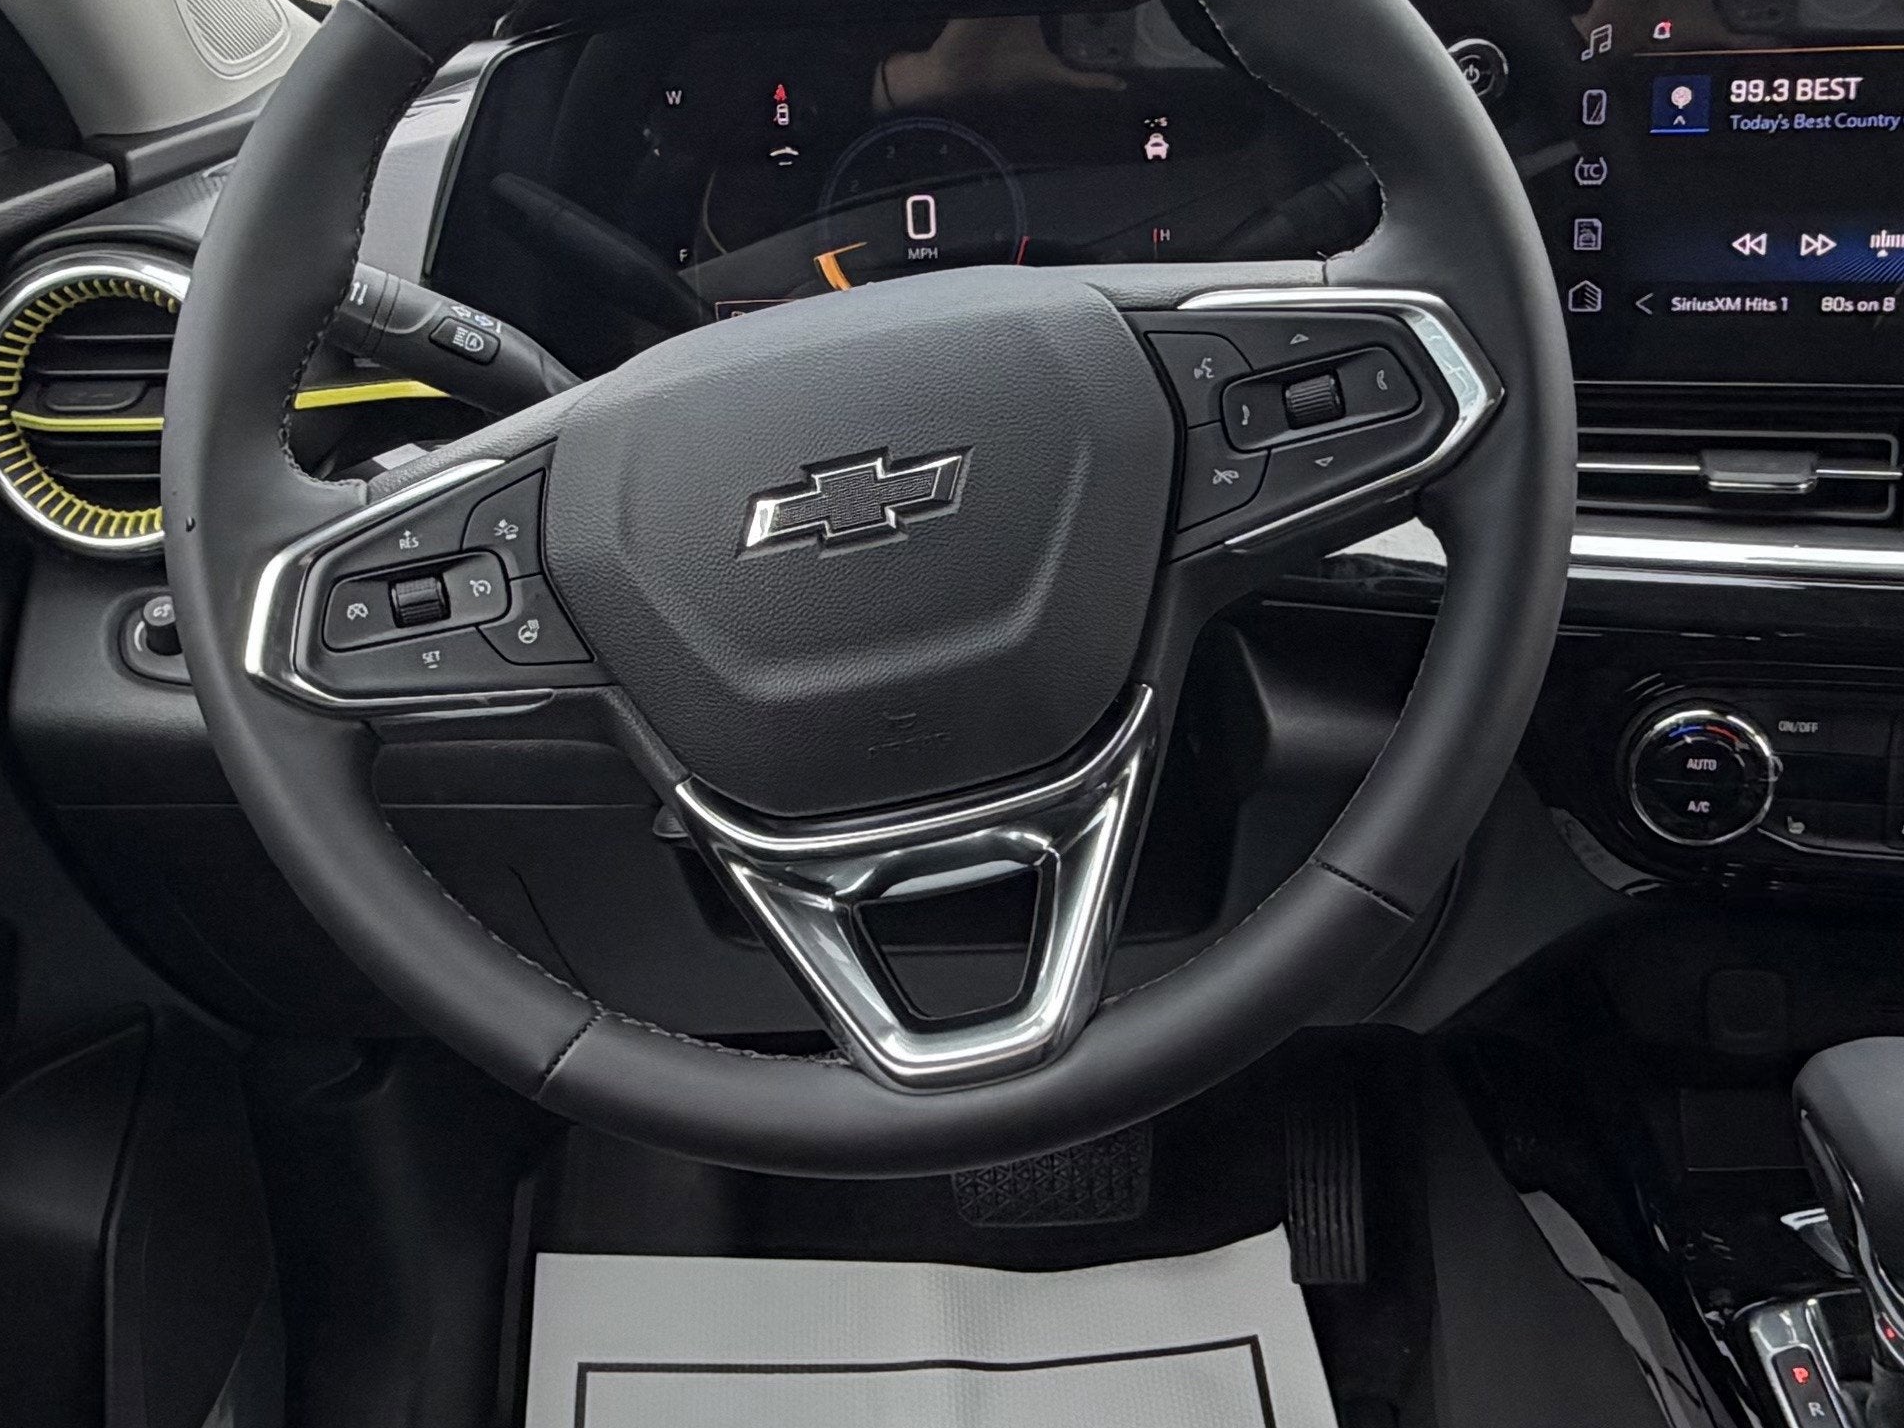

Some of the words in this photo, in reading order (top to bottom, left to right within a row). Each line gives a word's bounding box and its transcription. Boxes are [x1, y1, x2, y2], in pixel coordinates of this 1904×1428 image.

[1730, 79, 1790, 103] 99.3
[1796, 77, 1863, 101] BEST
[665, 90, 684, 106] W
[1730, 113, 1790, 133] Today's
[1794, 113, 1832, 129] Best
[1834, 112, 1900, 131] Country
[906, 194, 937, 240] 0
[1160, 227, 1171, 242] H
[907, 247, 938, 260] MPH
[1671, 296, 1741, 312] SiriusXM
[1744, 296, 1778, 312] Hits
[1780, 296, 1788, 312] 1
[1821, 296, 1854, 312] 80s
[1856, 300, 1880, 312] on
[399, 535, 419, 550] RES
[422, 650, 440, 664] SET
[1686, 758, 1717, 771] AUTO
[1687, 800, 1710, 813] A/C
[1792, 1366, 1810, 1385] P
[1808, 1402, 1825, 1417] R
